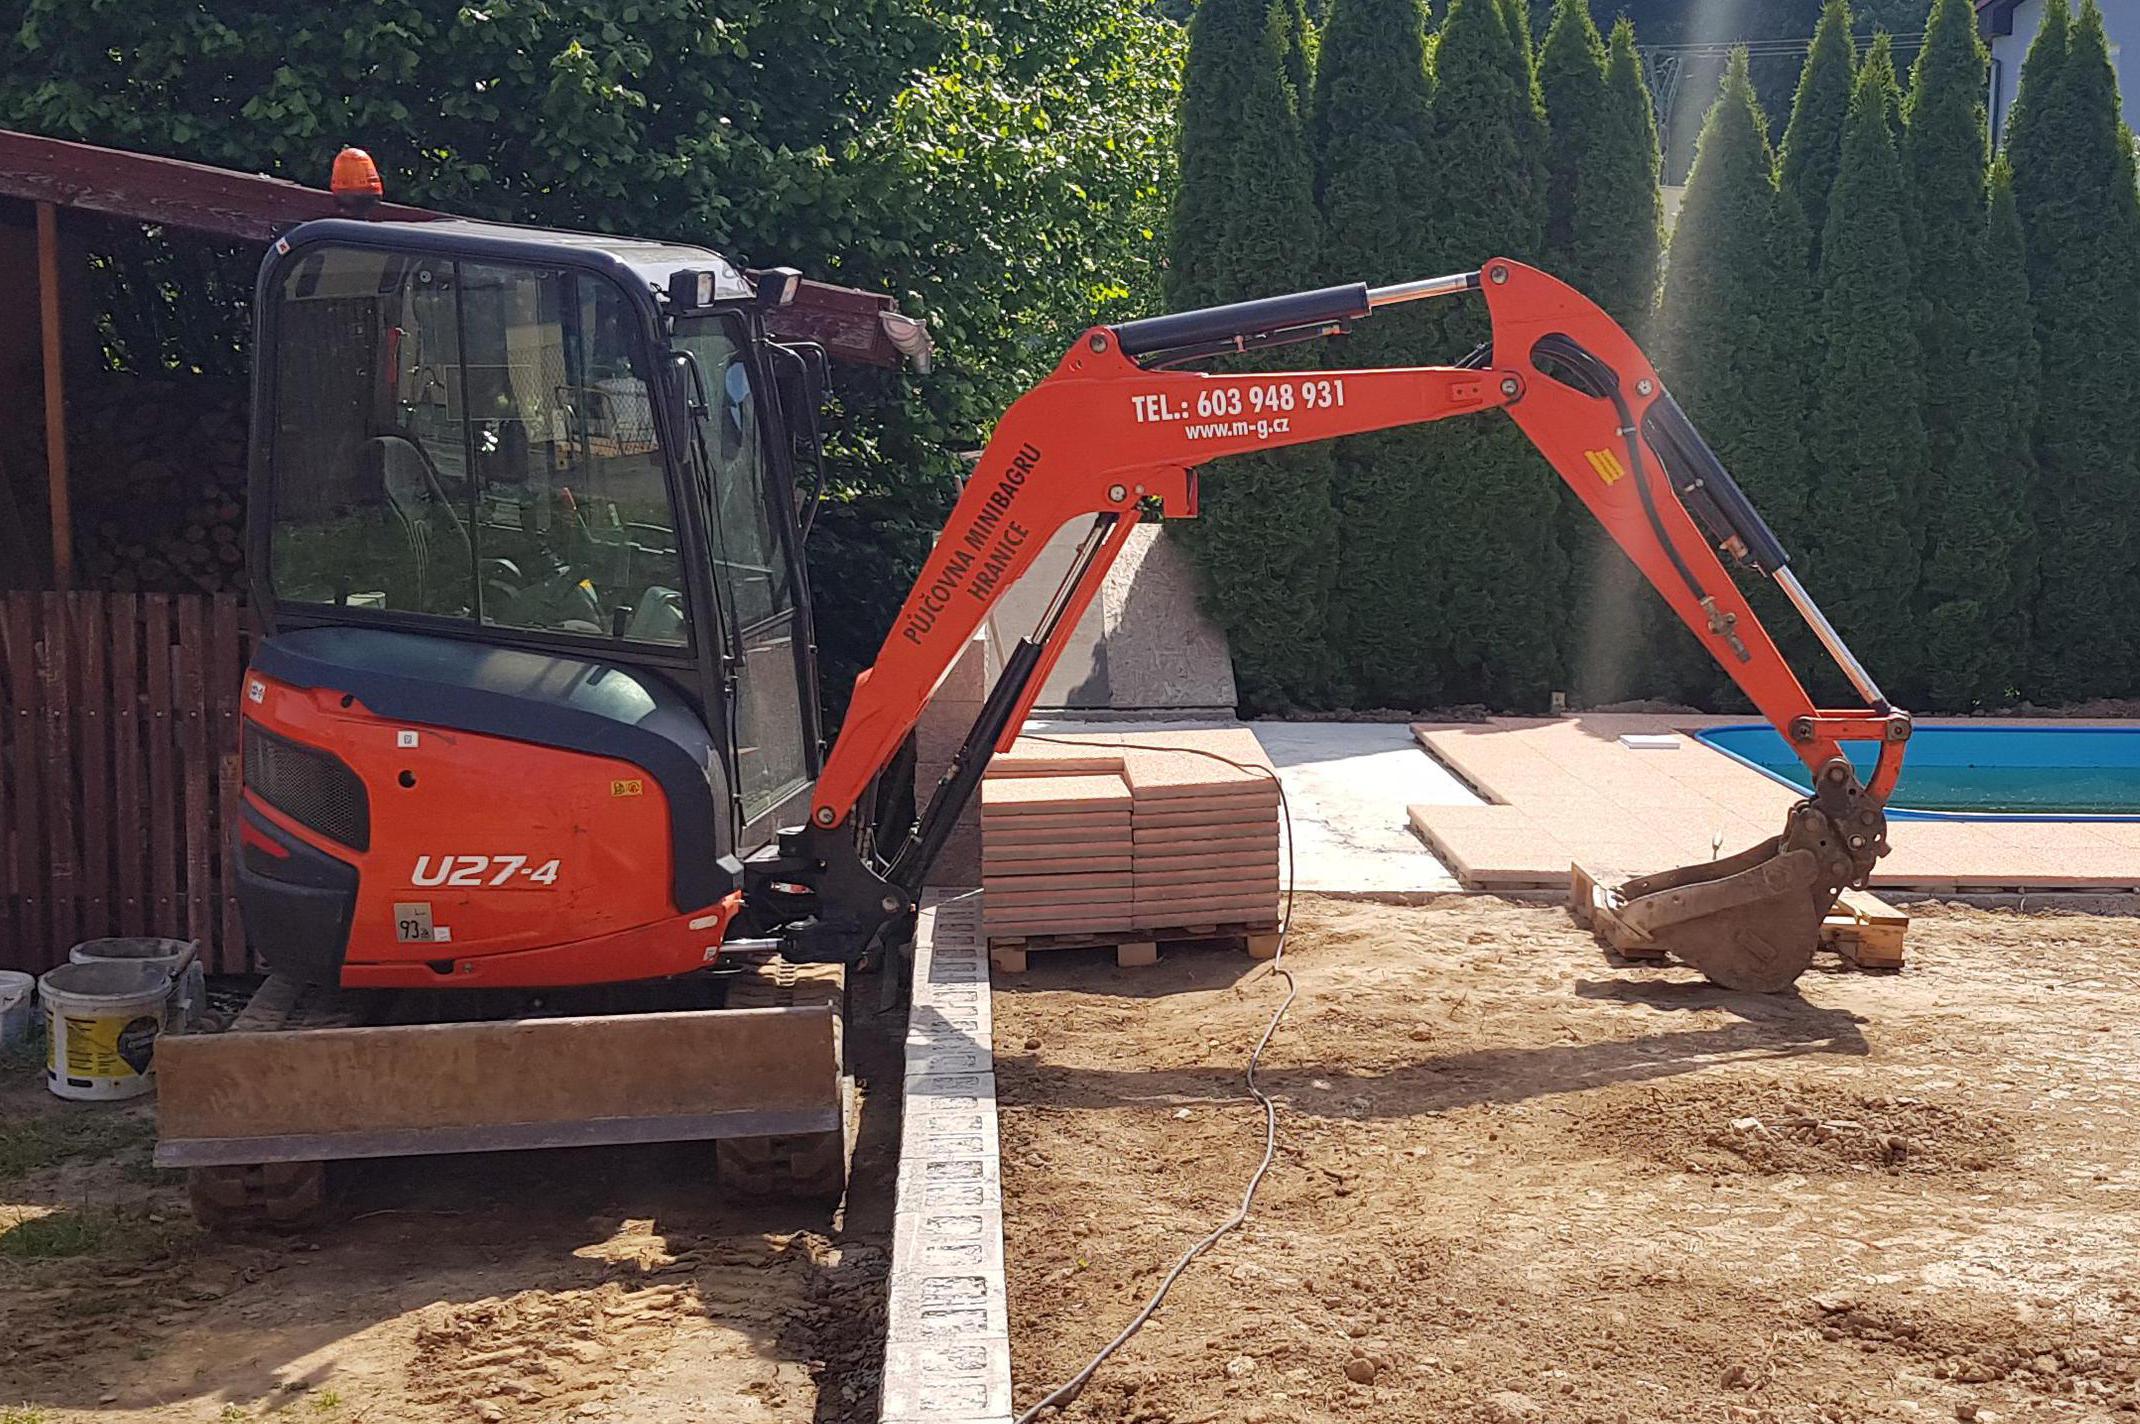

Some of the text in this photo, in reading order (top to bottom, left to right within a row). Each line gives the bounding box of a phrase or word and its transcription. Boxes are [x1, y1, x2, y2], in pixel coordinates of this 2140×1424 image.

[1131, 379, 1344, 422] TEL.: 603 948 931
[1185, 418, 1290, 440] www.m-g.cz
[903, 442, 1041, 645] PŮJČOVNA MINIBAGRU
[967, 520, 1029, 602] HRANICE
[411, 855, 560, 886] U27-4
[399, 920, 420, 939] 93
